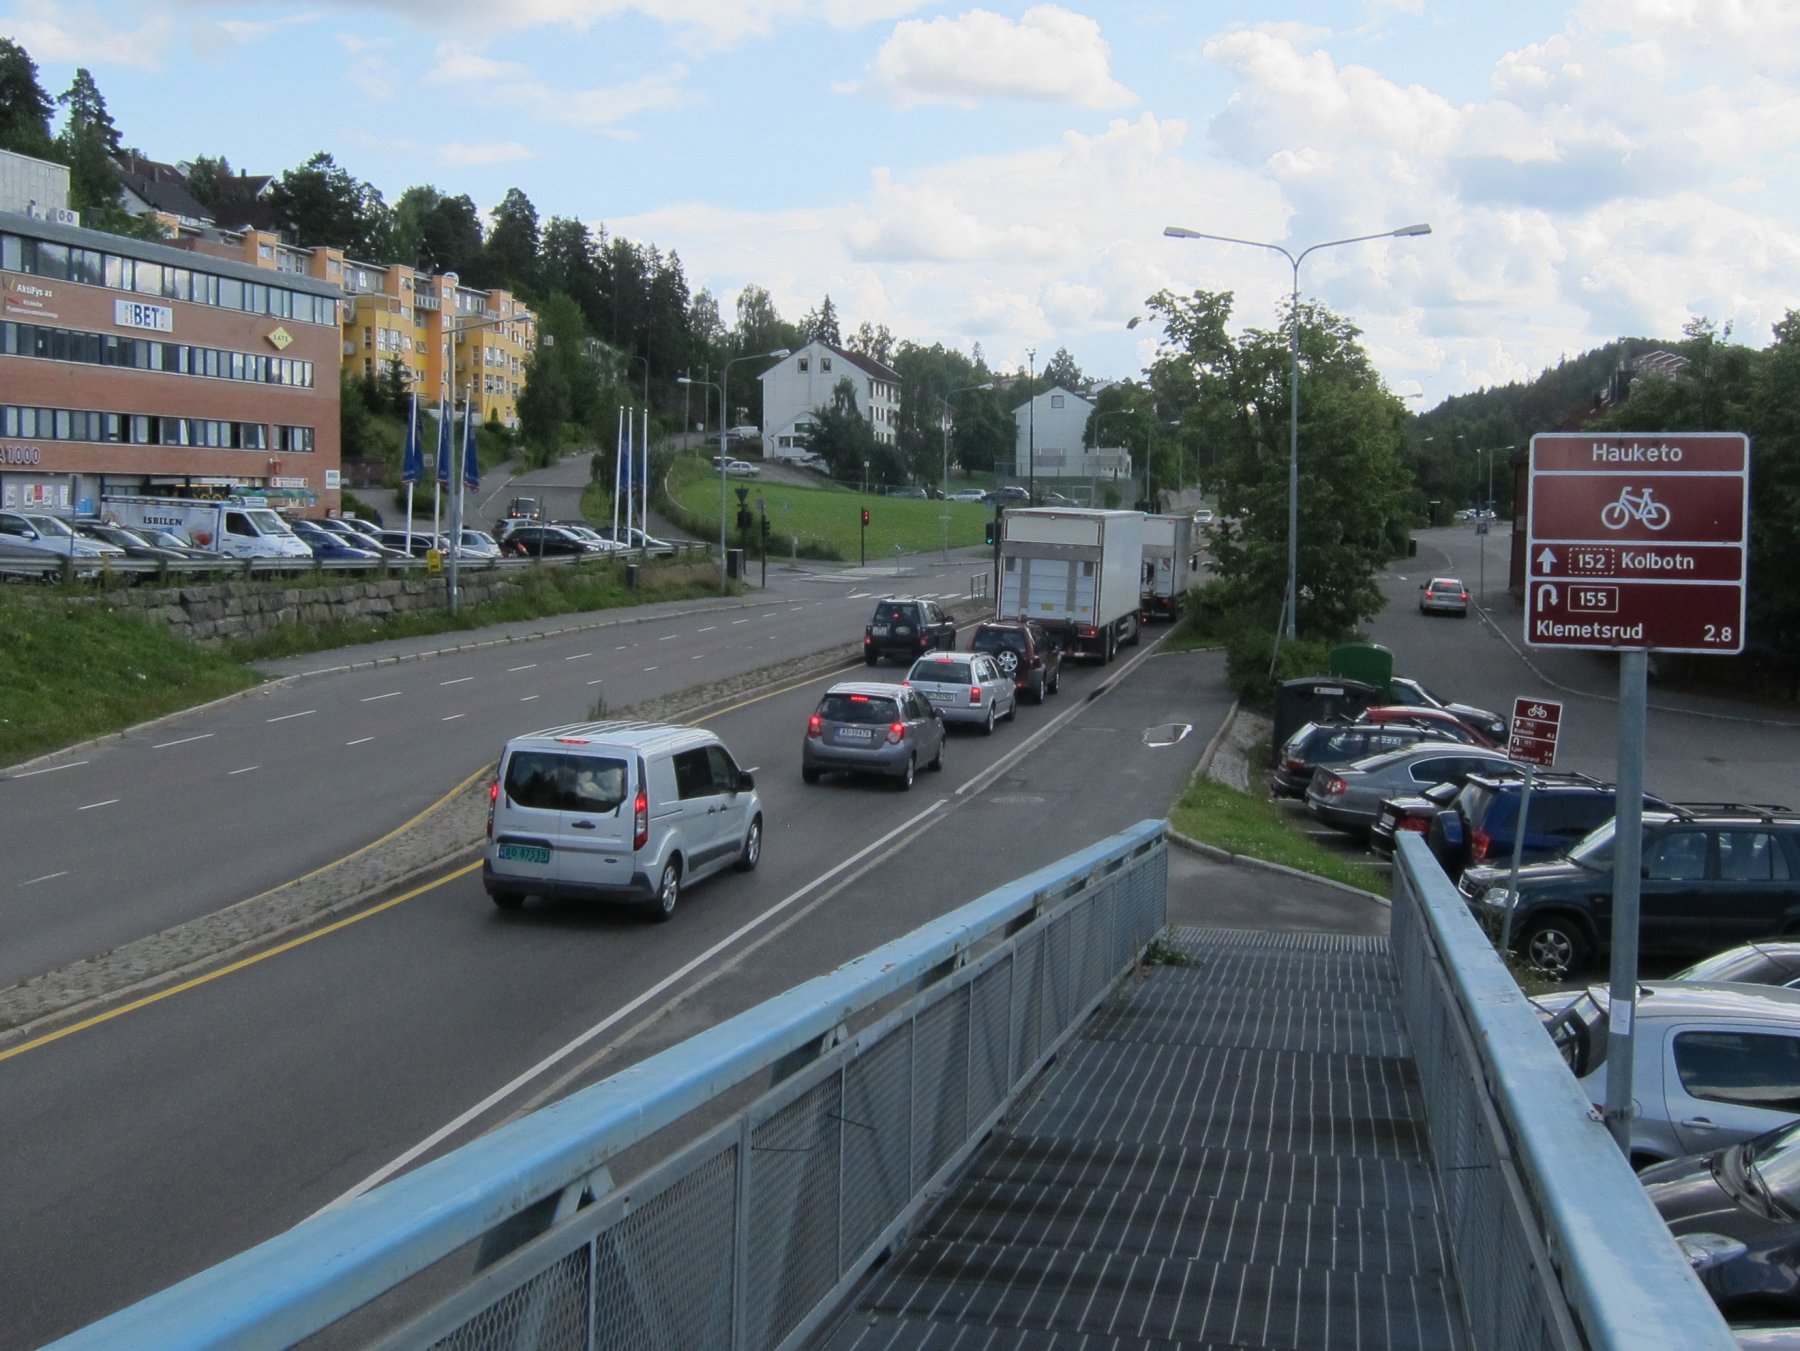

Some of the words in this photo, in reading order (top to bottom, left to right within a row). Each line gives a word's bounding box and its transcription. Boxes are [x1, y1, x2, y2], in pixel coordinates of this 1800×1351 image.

[134, 304, 160, 328] BET
[7, 446, 41, 465] 1000
[1592, 443, 1683, 462] Hauketo
[143, 516, 183, 526] ISBILEN
[1578, 554, 1606, 569] 152
[1621, 552, 1695, 570] Kolbotn
[1579, 592, 1607, 607] 155
[1536, 620, 1643, 639] Klemetsrud
[1703, 624, 1732, 643] 2,8
